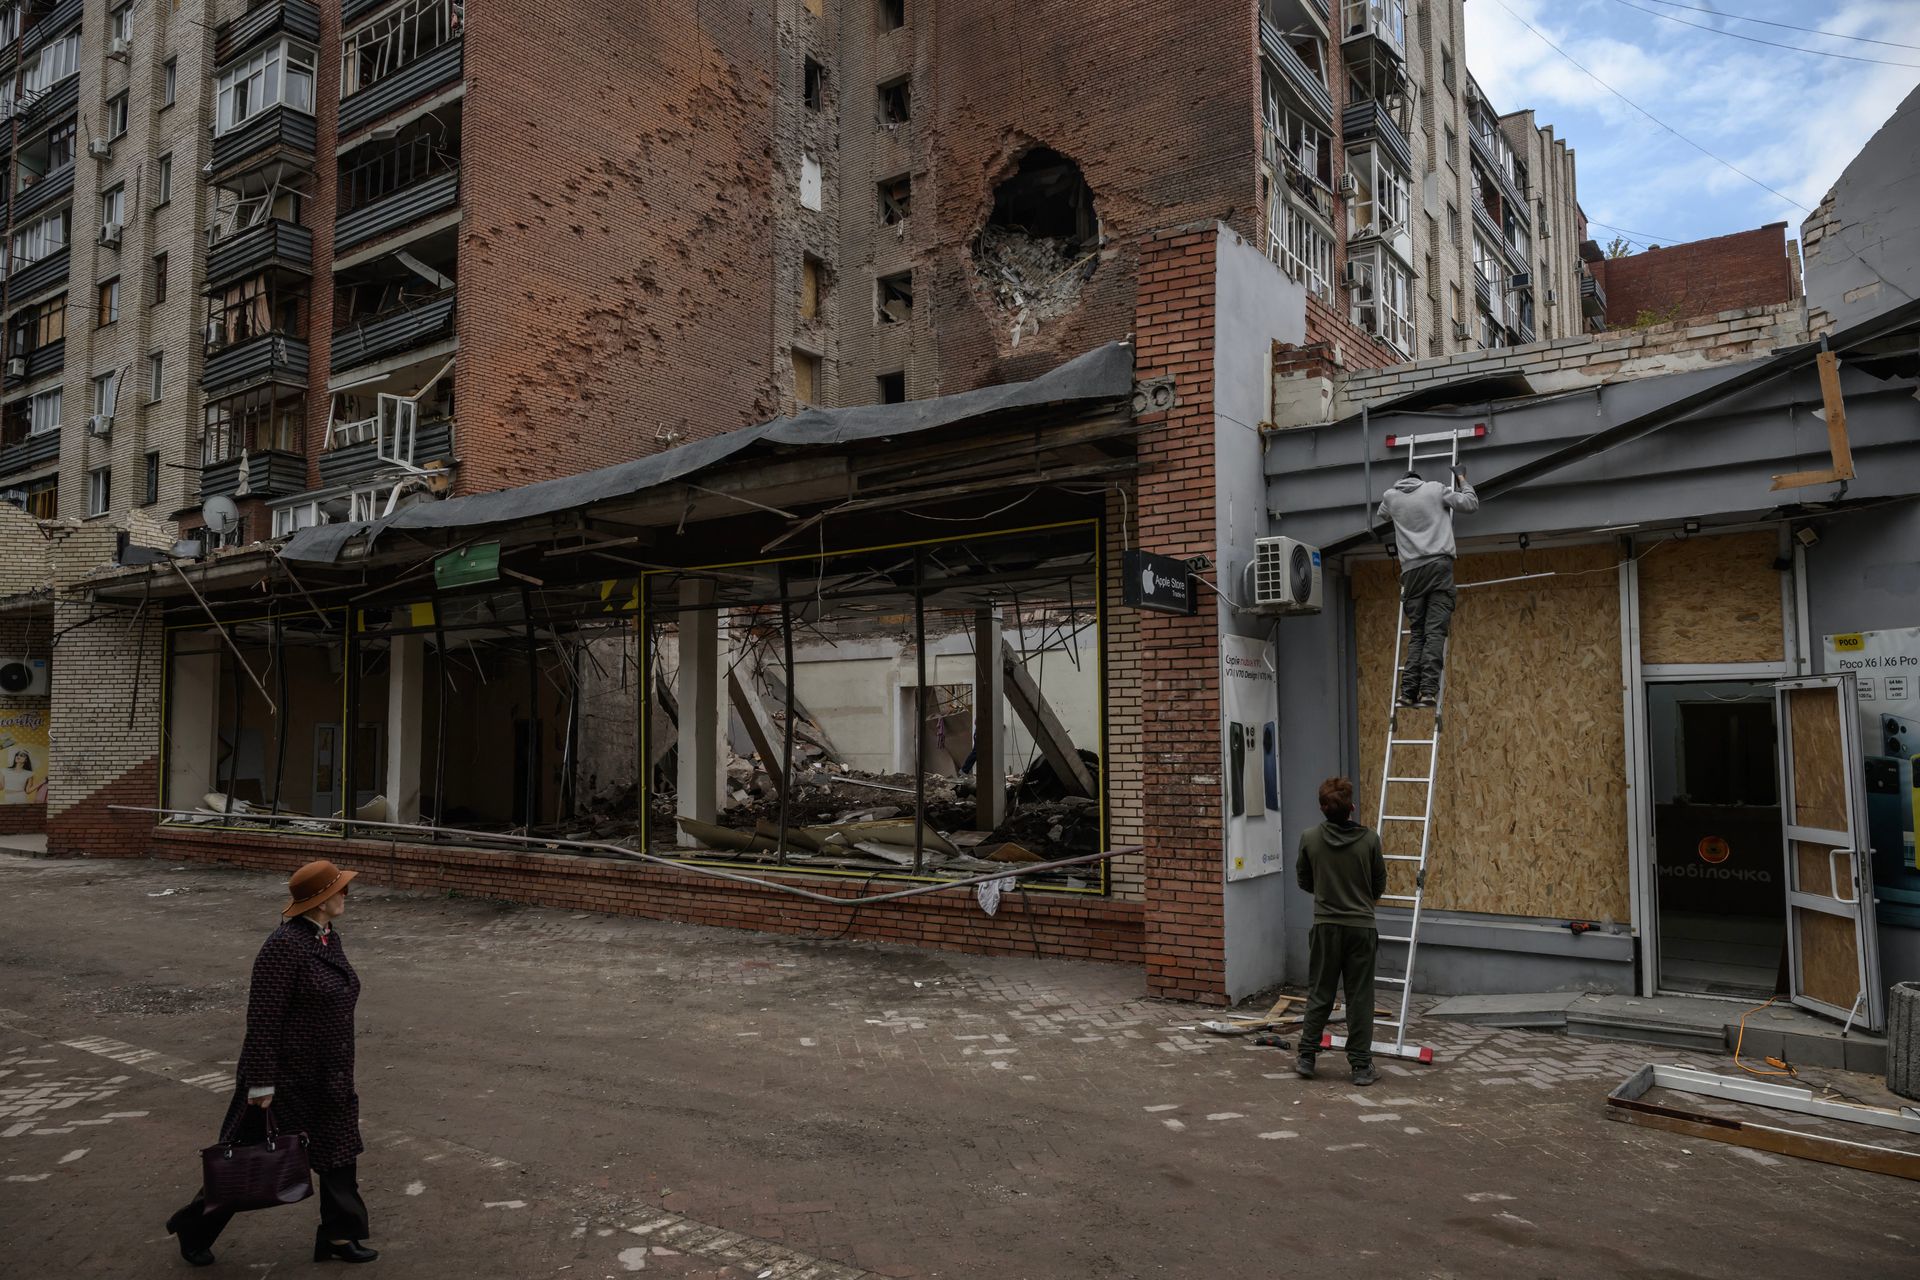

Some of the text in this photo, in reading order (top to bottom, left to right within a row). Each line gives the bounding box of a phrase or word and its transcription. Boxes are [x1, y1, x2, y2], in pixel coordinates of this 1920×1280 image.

[1155, 574, 1185, 590] Apple Store
[1839, 659, 1863, 669] Poco
[1865, 657, 1877, 668] X6
[1884, 656, 1897, 667] X6
[1899, 656, 1918, 666] Pro
[1658, 863, 1772, 883] мобілочка
